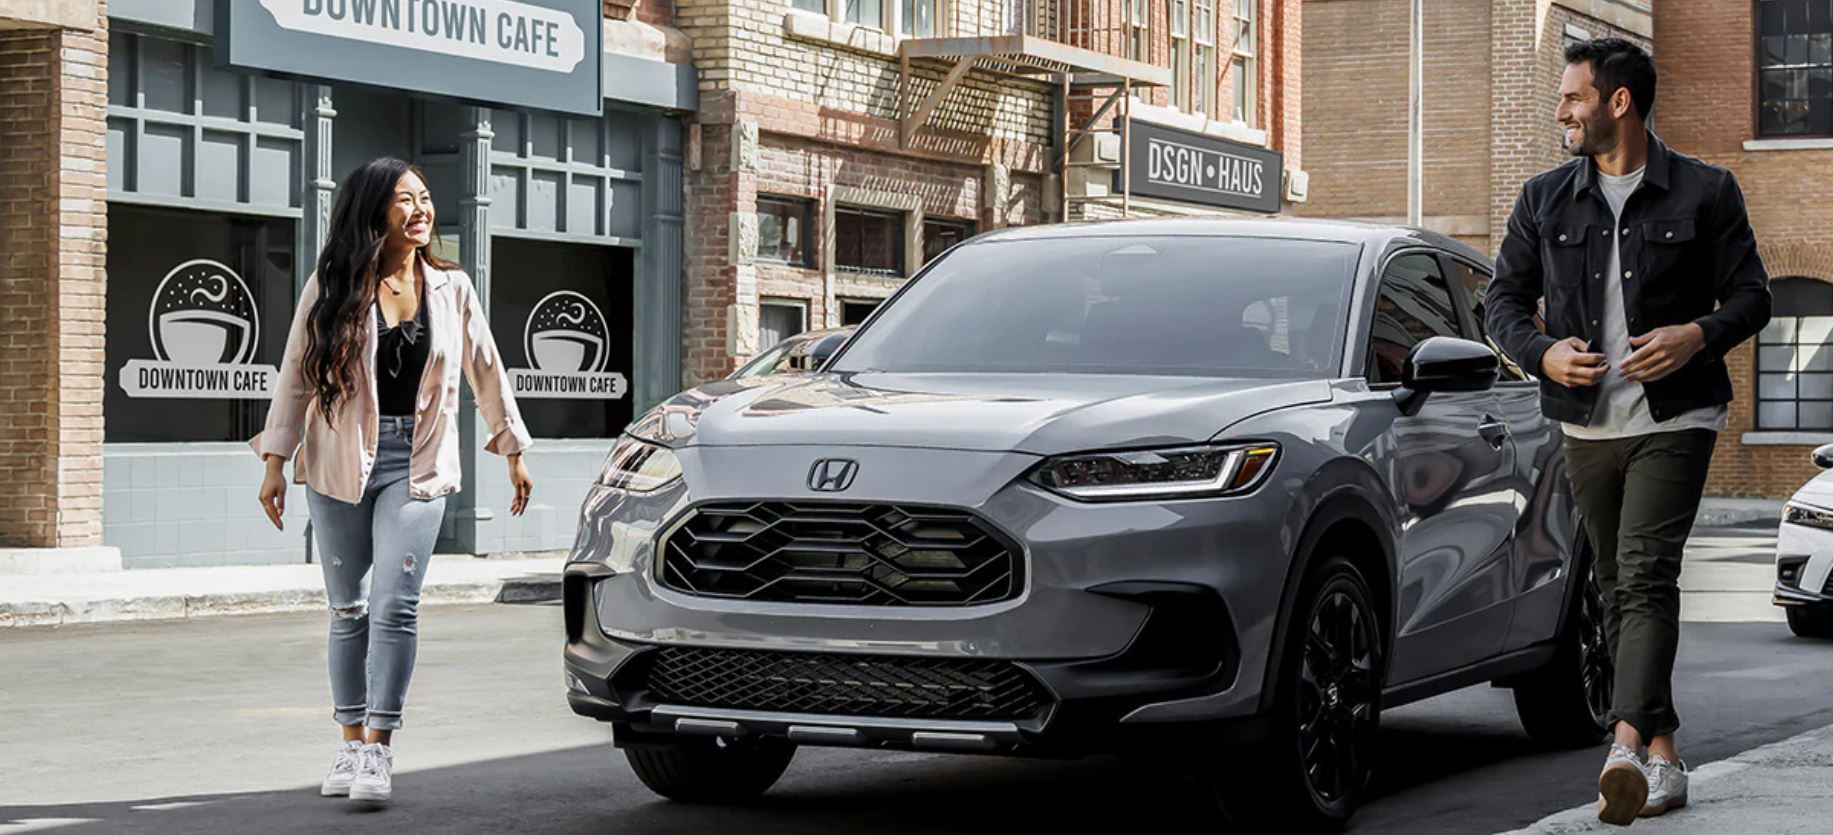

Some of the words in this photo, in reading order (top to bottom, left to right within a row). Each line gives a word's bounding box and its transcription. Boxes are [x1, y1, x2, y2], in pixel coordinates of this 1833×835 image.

[496, 12, 559, 57] CAFE
[1148, 142, 1203, 186] DSGN
[1218, 156, 1263, 194] HAUS
[138, 367, 228, 391] DOWNTOWN
[233, 370, 268, 391] CAFE
[516, 374, 586, 393] DOWNTOWN
[589, 377, 616, 393] CAFE
